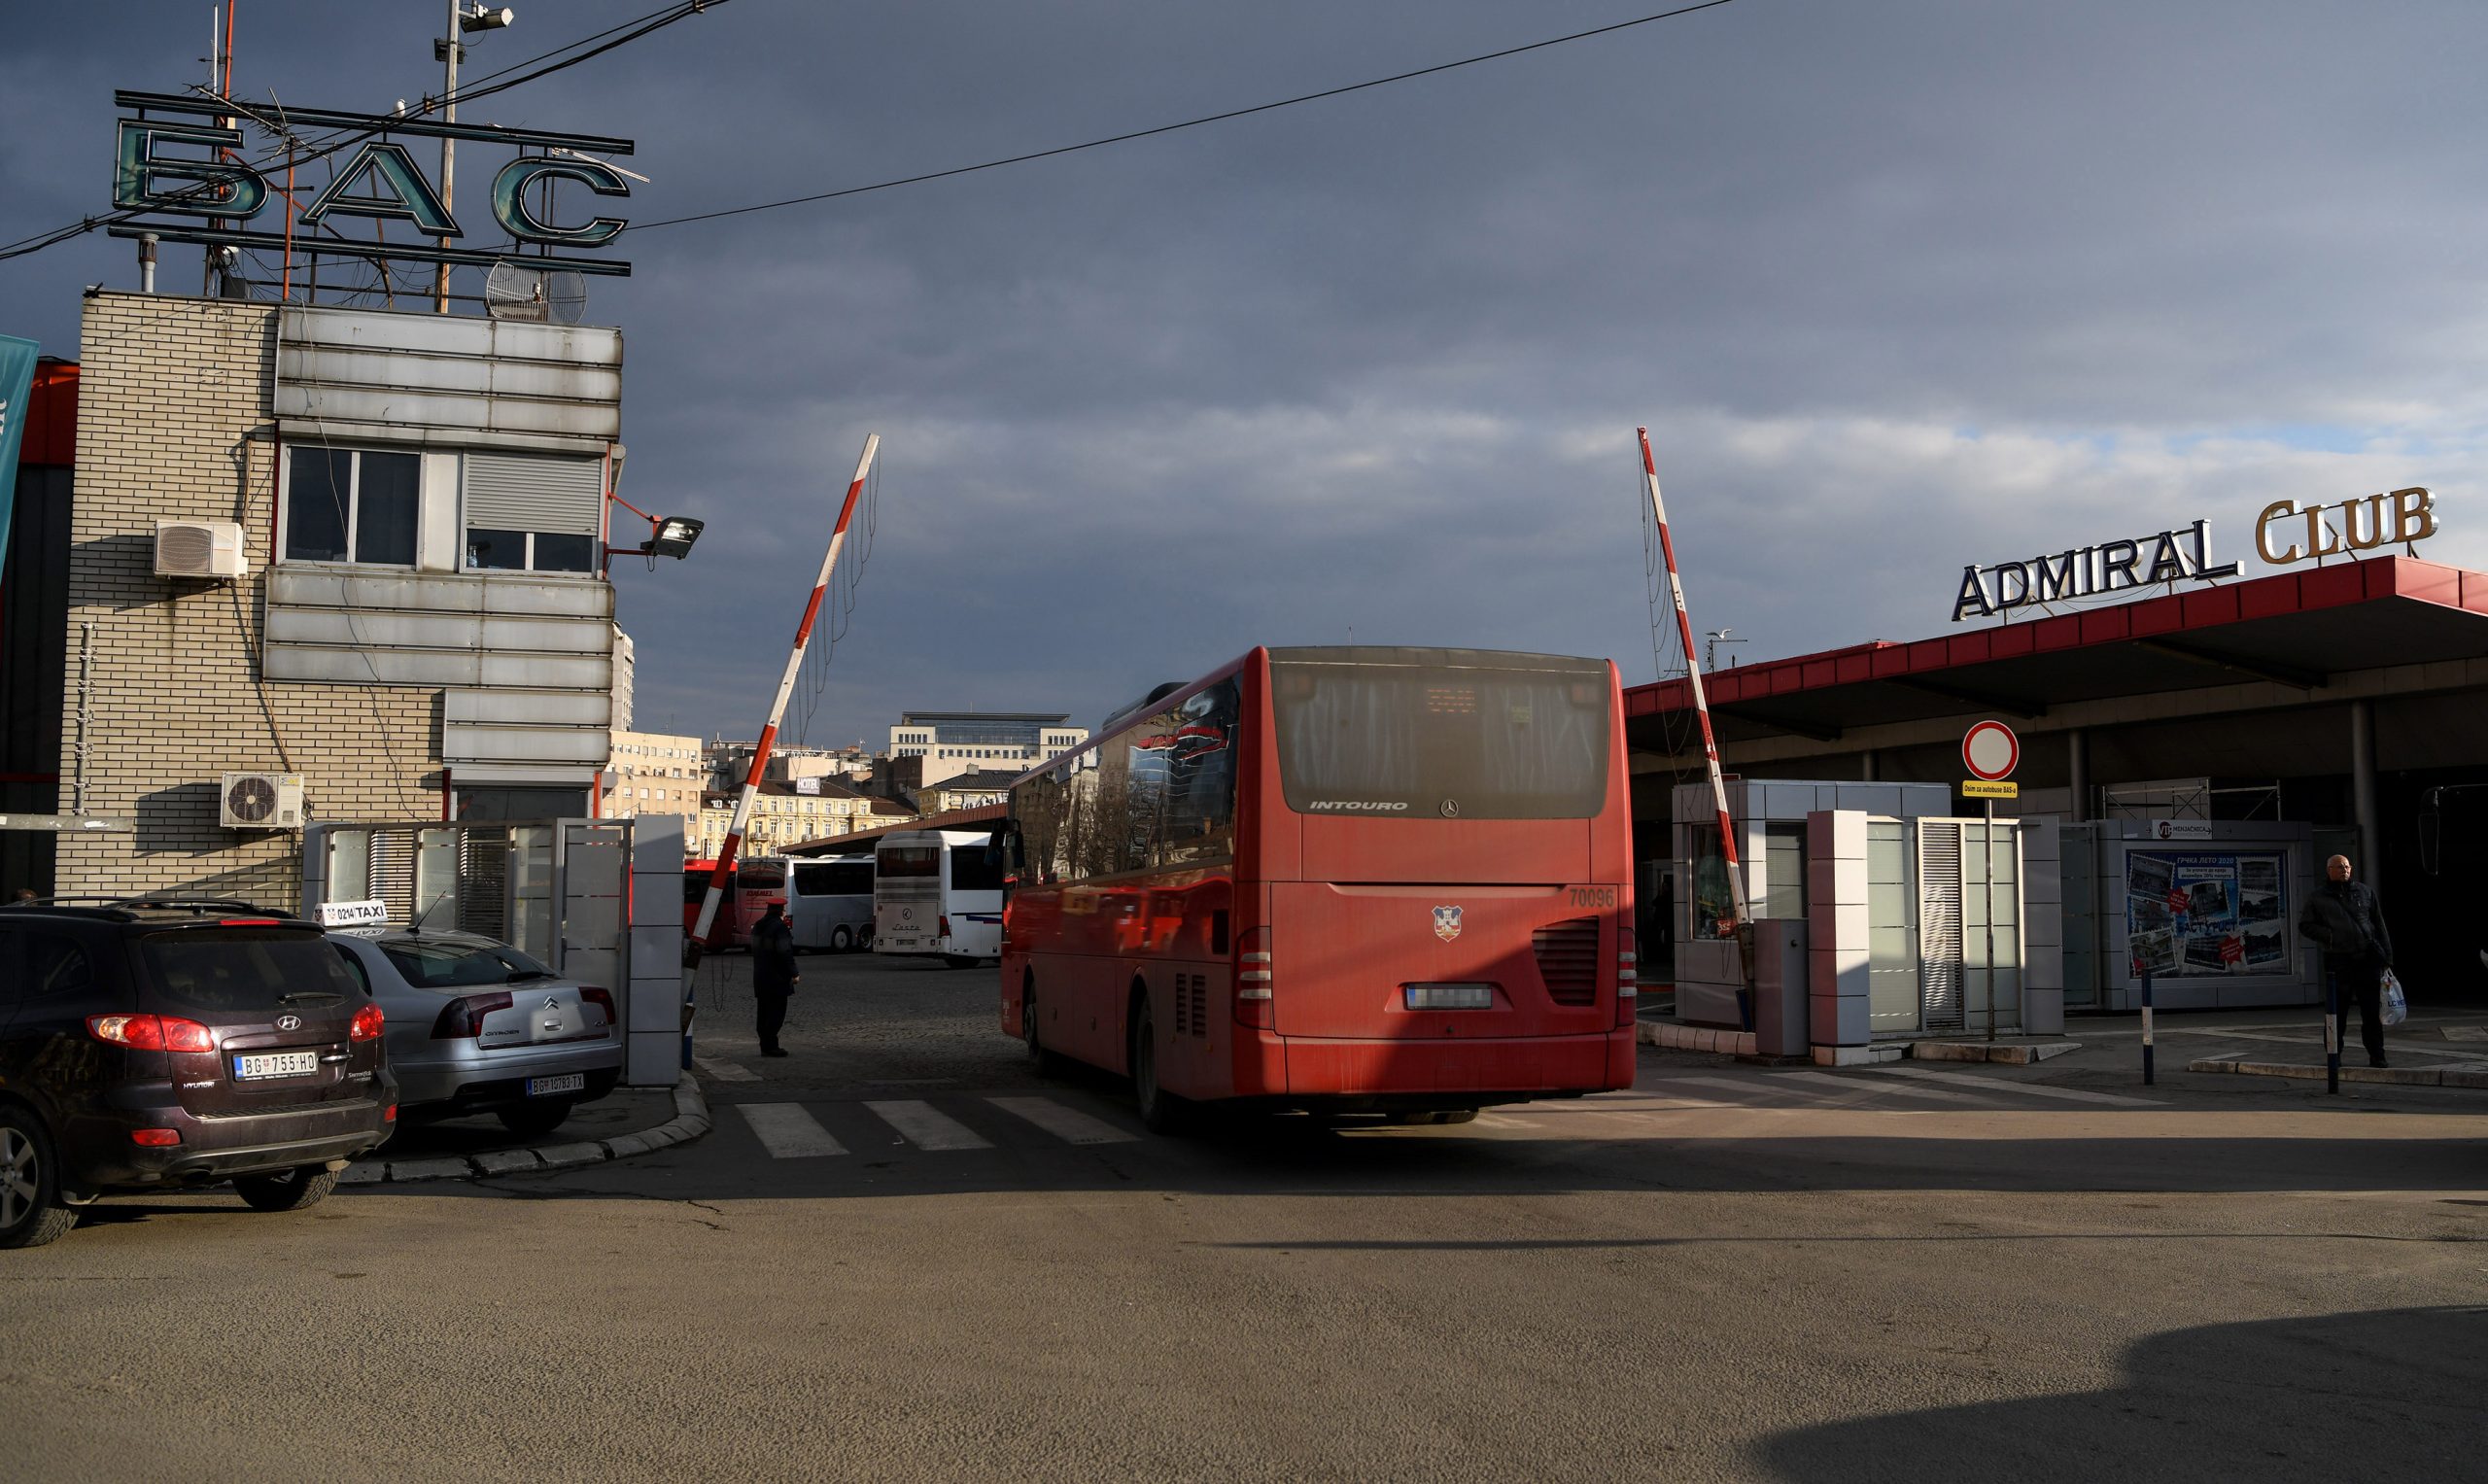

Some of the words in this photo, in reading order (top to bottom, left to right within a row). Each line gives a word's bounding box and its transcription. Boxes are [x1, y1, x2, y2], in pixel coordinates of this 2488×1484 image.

[111, 117, 631, 249] БАС
[1951, 518, 2246, 622] ADMIRAL
[2255, 486, 2440, 565] CLUB
[797, 777, 820, 789] HOTEL
[1309, 801, 1408, 811] INTOURO
[1570, 888, 1615, 909] 70096
[337, 908, 355, 920] 0214
[356, 906, 385, 918] TAXI
[245, 1058, 261, 1075] BG
[183, 1081, 216, 1089] HYUNDAI
[533, 1080, 544, 1093] BG
